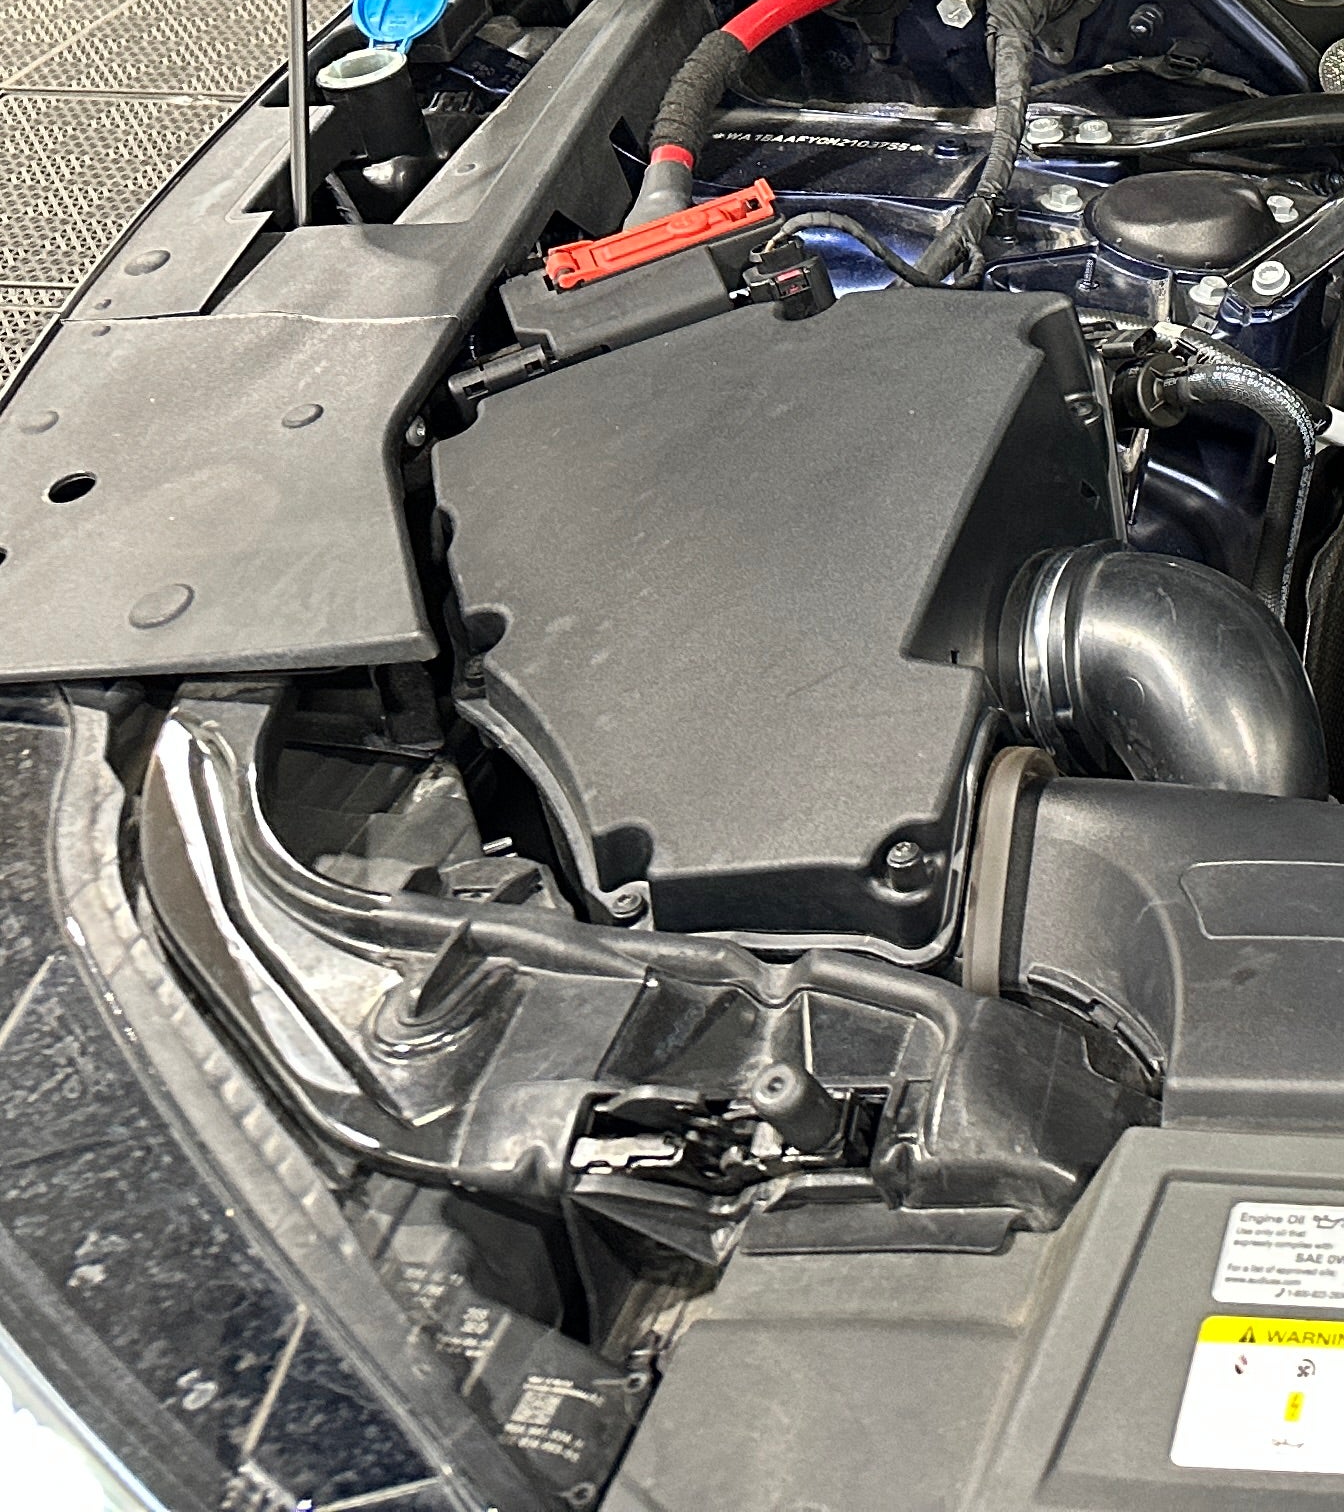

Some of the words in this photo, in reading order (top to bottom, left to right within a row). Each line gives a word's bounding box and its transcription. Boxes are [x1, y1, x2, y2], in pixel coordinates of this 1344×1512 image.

[1240, 1212, 1284, 1225] Engine
[1287, 1214, 1306, 1225] Oil
[1295, 1253, 1324, 1265] SAE
